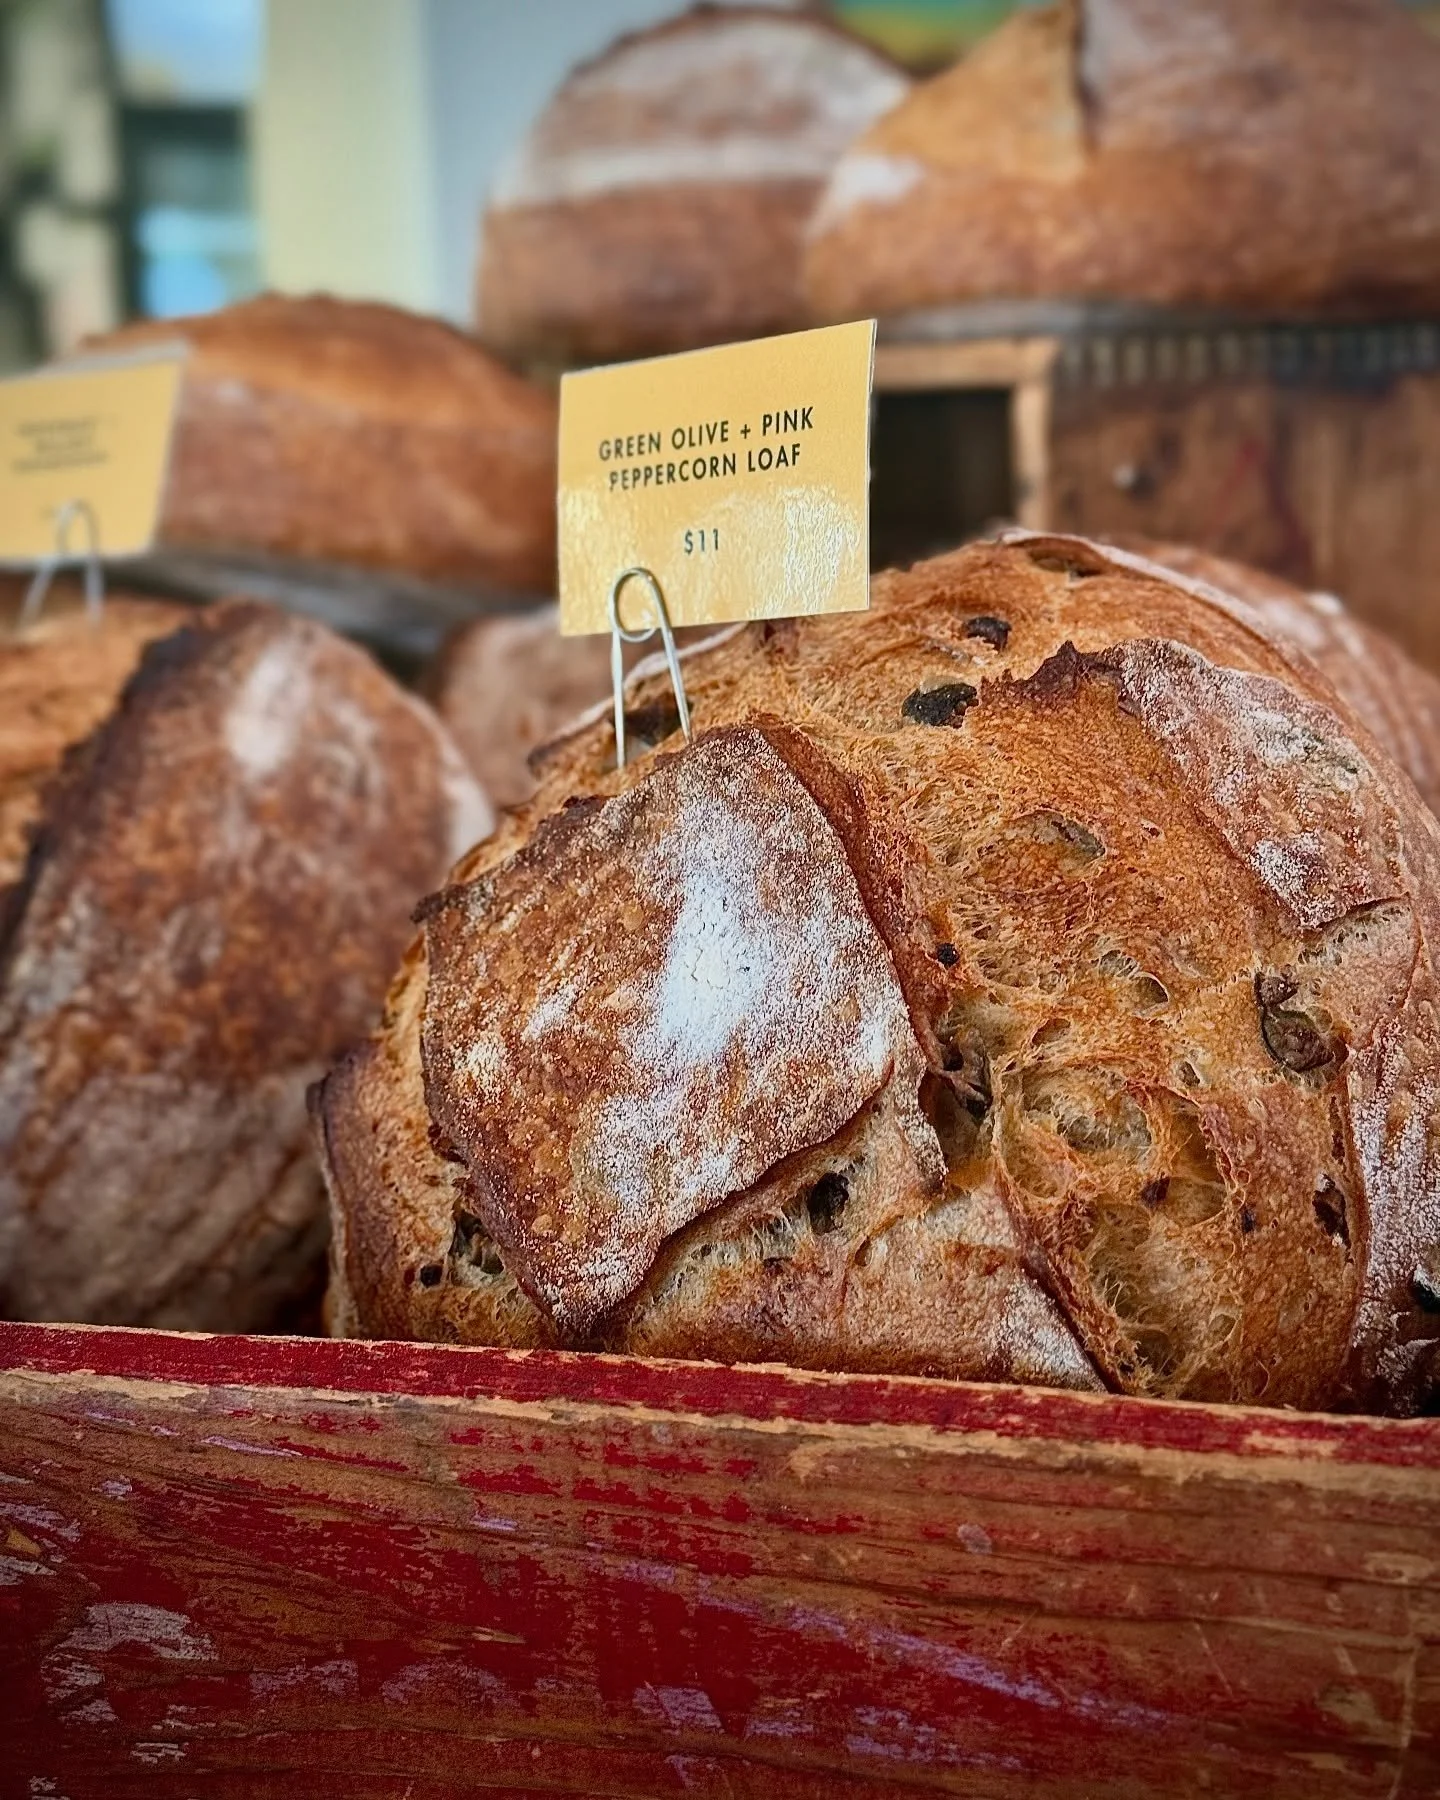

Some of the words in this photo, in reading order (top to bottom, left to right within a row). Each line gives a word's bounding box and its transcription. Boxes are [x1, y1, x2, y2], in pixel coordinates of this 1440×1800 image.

[599, 431, 661, 461] GREEN
[671, 420, 729, 450] OLIVE
[740, 424, 751, 440] +
[762, 406, 814, 437] PINK
[609, 453, 737, 492] PEPPERCORN
[748, 443, 801, 473] LOAF
[684, 528, 719, 555] $11
